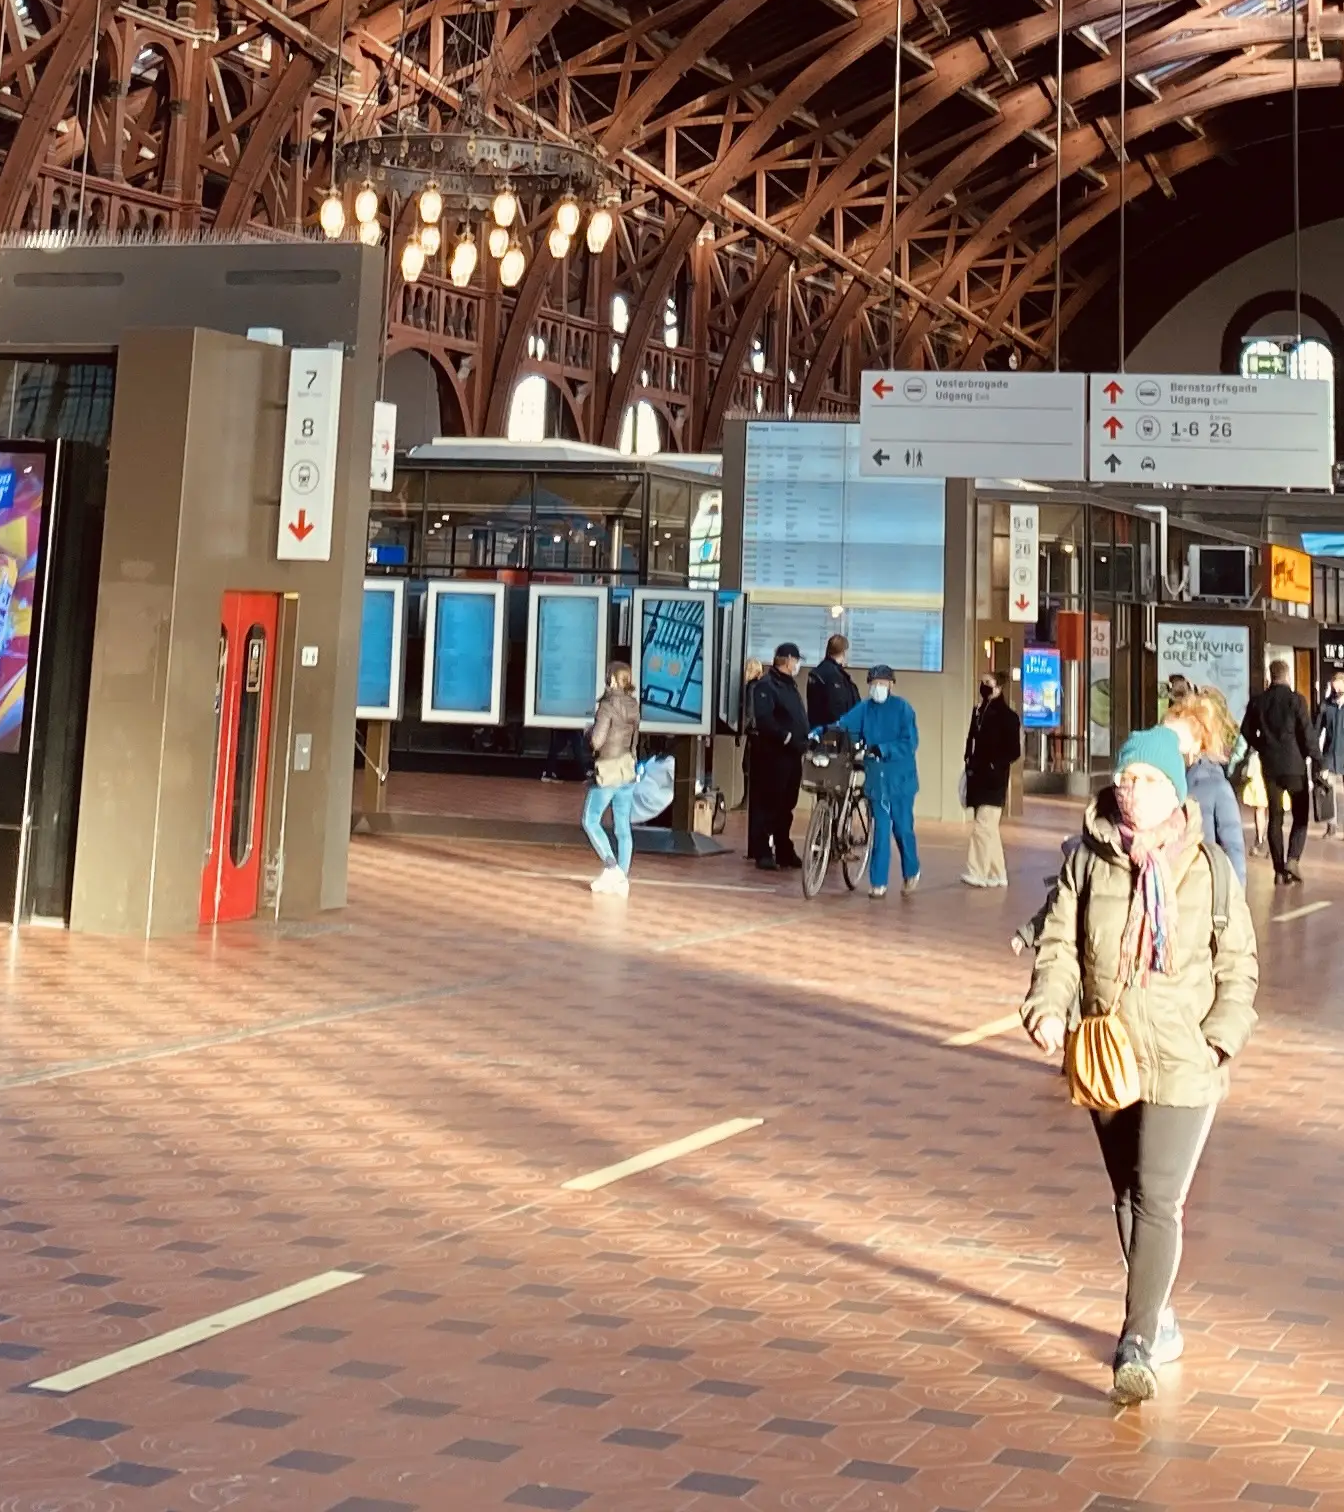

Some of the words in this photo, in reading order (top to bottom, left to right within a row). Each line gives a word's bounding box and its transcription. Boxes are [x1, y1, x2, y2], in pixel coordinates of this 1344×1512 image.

[306, 370, 317, 389] 7
[936, 379, 1008, 390] Vesterbrogade
[936, 392, 972, 402] Udgang
[1170, 396, 1210, 406] Udgang
[302, 418, 314, 437] 8
[1171, 421, 1199, 436] 1-6
[1210, 422, 1232, 437] 26
[1167, 629, 1206, 643] NOW
[1186, 641, 1244, 655] SERVING
[1163, 651, 1209, 665] GREEN
